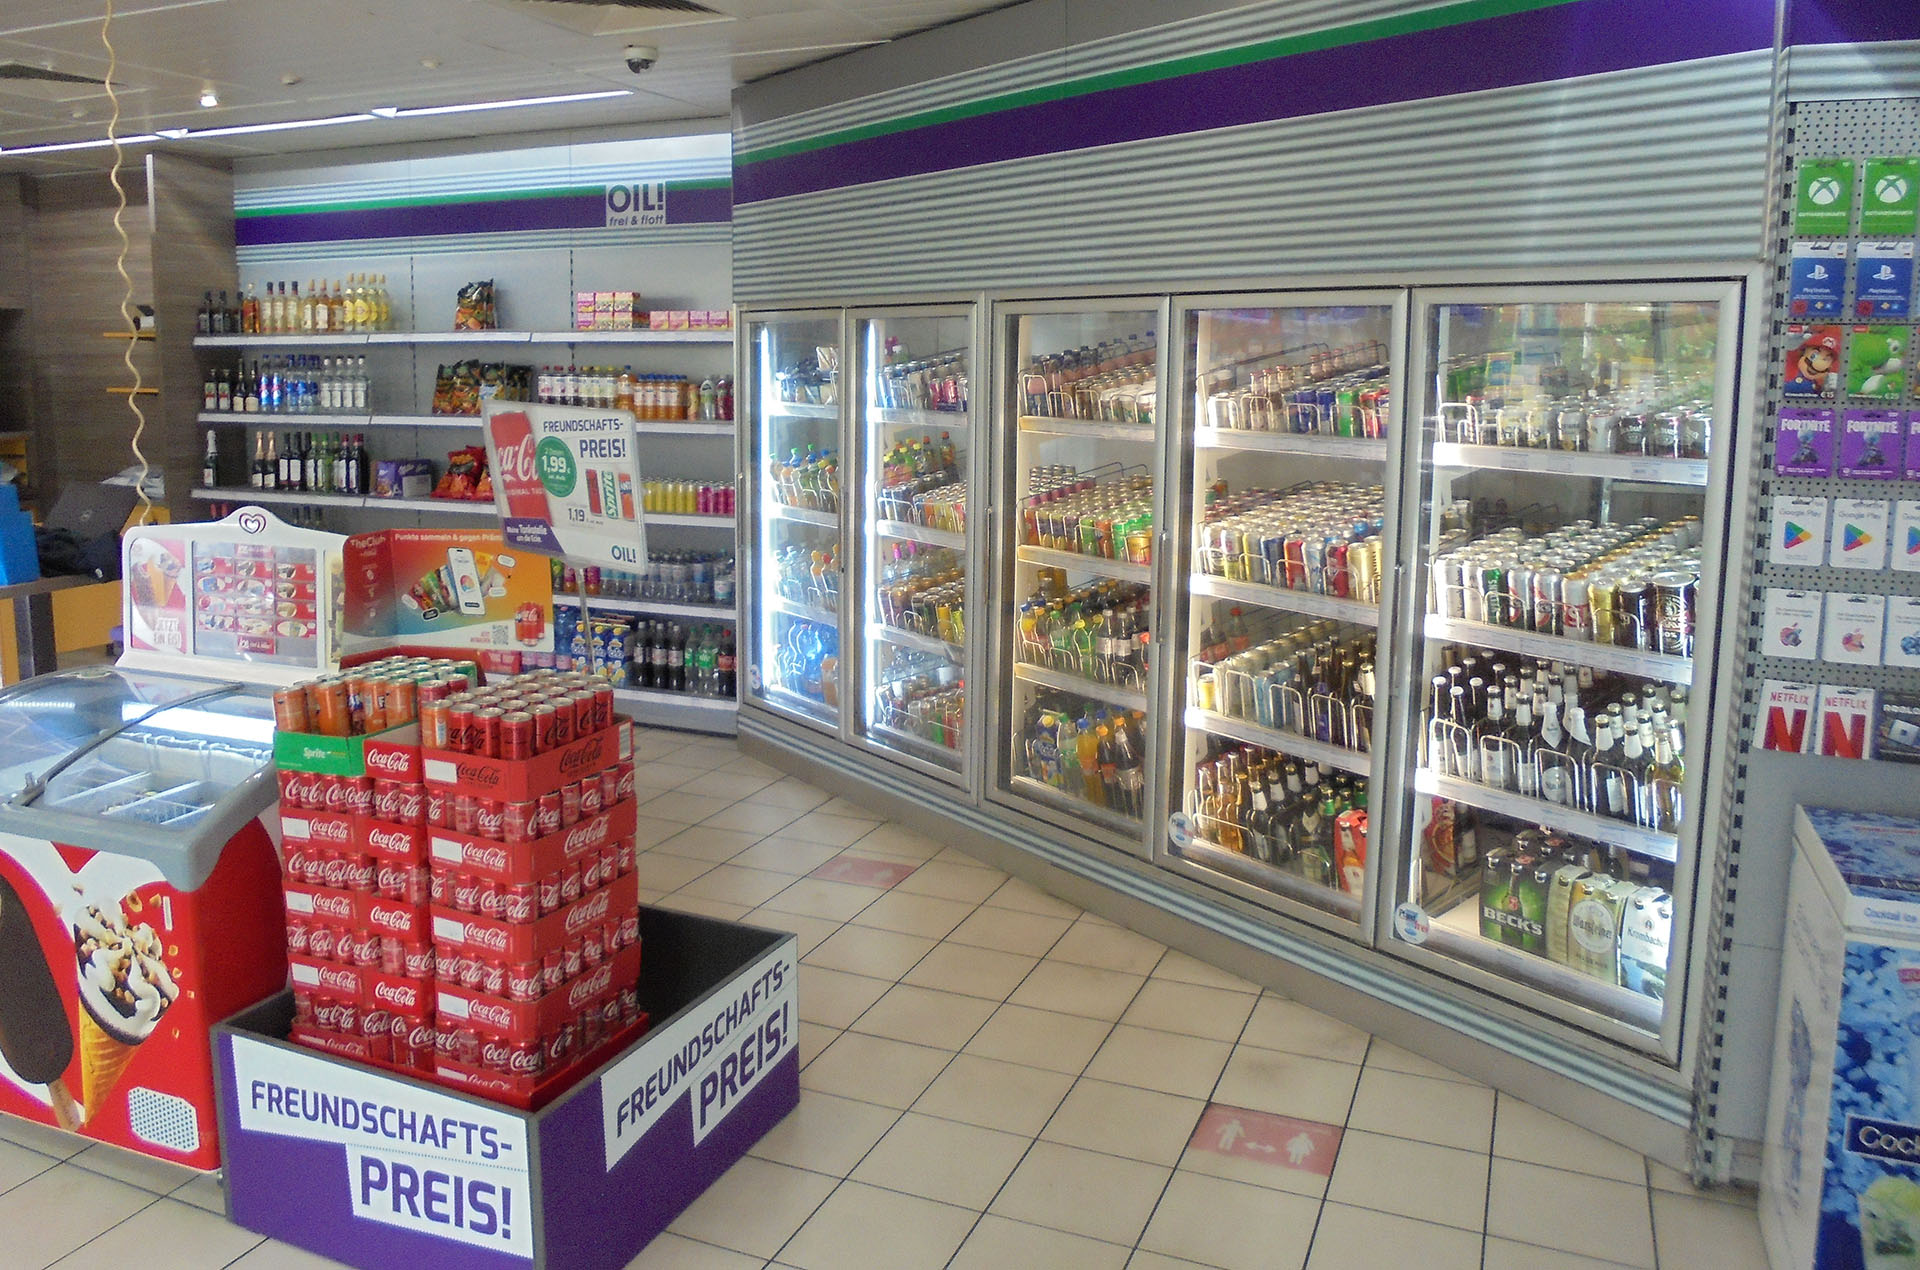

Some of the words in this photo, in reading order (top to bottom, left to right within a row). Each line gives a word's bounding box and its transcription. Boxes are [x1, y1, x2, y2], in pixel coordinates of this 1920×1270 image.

[608, 183, 664, 212] OIL!
[543, 418, 624, 432] FREUNDSCHAFTS-
[1781, 419, 1831, 432] FORTNITE
[1846, 420, 1898, 433] FORTNITE
[579, 438, 626, 458] PREIS!
[611, 545, 637, 563] OIL!
[1770, 691, 1809, 705] NETFLIX
[1825, 696, 1867, 710] NETFLIX
[303, 747, 326, 759] Sprite
[369, 828, 412, 853] Coca-Cola
[463, 842, 507, 867] Coca-Cola
[371, 905, 412, 931] Coca-Cola
[1483, 906, 1543, 936] BECK'S
[464, 922, 508, 948] Coca-Cola
[375, 982, 417, 1006] Coca-Cola
[469, 999, 511, 1025] Coca-Cola
[617, 960, 790, 1138] FREUNDSCHAFTS-
[699, 1001, 788, 1130] PREIS!
[251, 1080, 512, 1160] FREUNDSCHAFTS-
[360, 1155, 512, 1240] PREIS!
